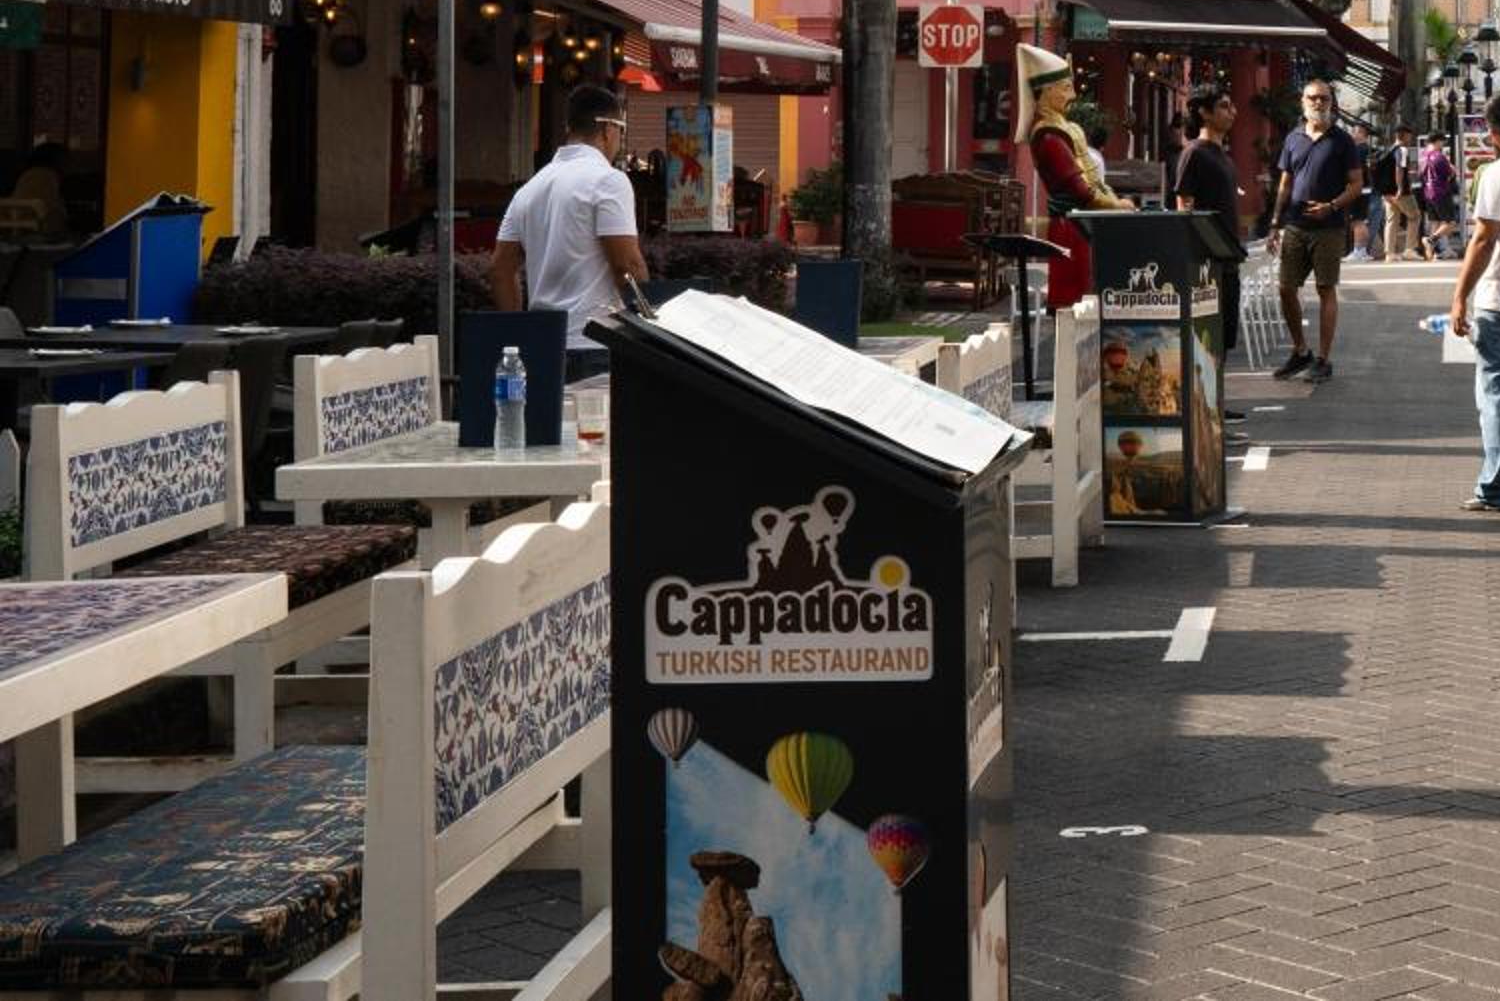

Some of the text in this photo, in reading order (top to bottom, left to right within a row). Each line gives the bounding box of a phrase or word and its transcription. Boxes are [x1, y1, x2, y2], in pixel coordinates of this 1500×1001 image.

[923, 24, 979, 48] STOP
[656, 581, 928, 646] Cappadocia
[656, 646, 929, 676] TURKISH RESTAURAND
